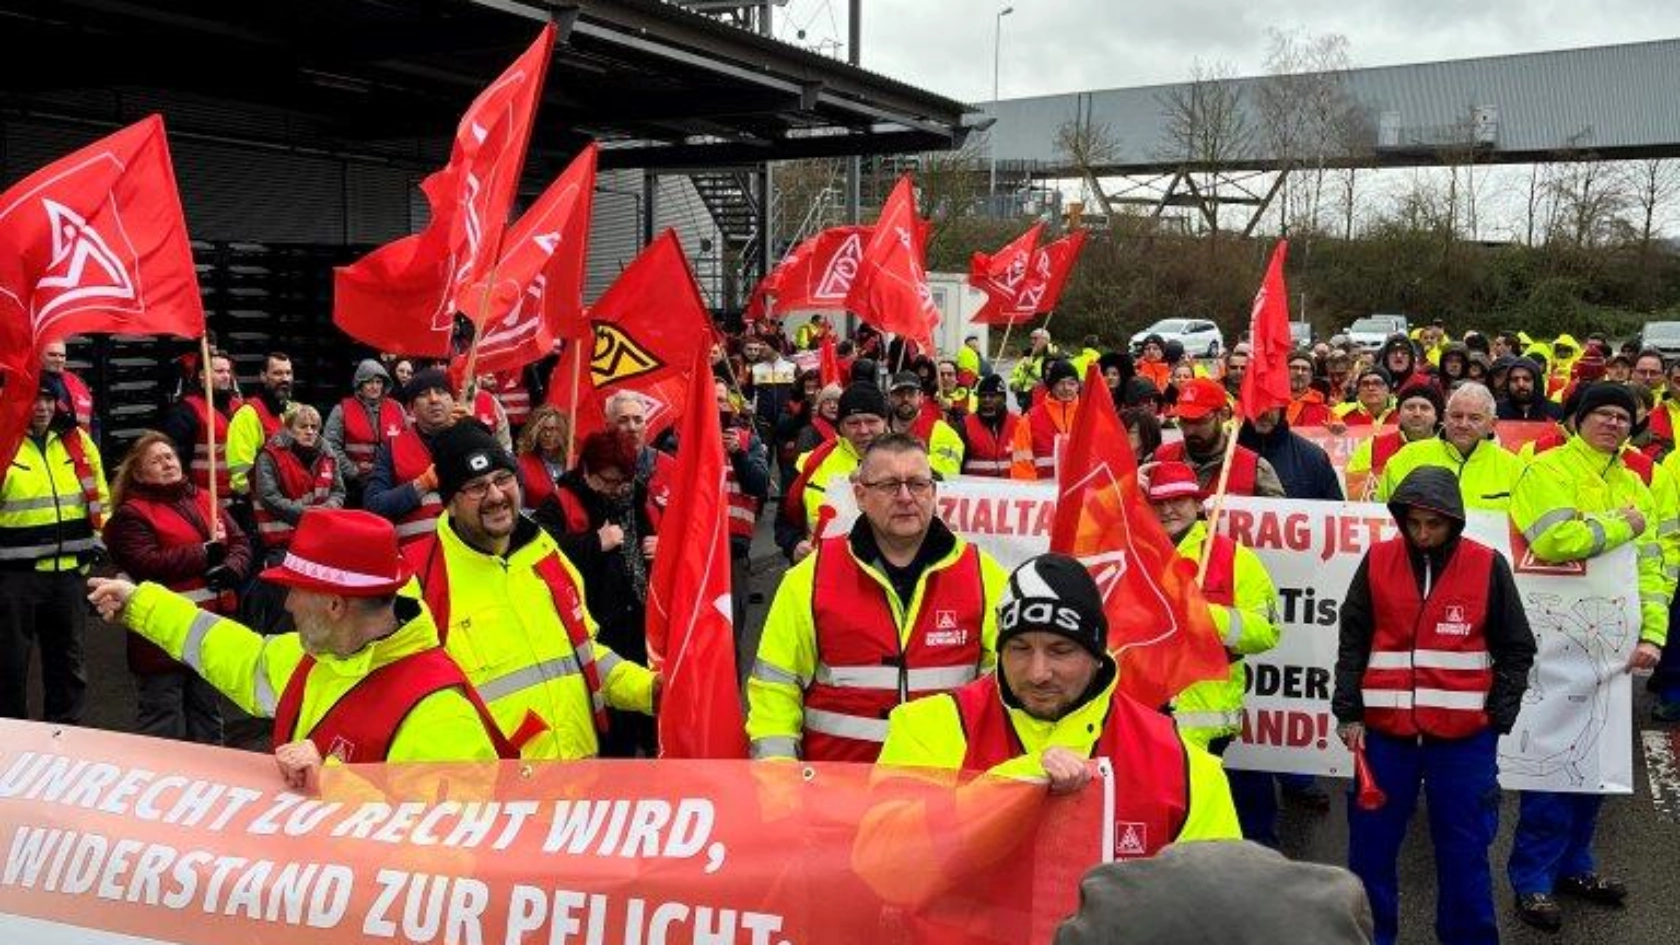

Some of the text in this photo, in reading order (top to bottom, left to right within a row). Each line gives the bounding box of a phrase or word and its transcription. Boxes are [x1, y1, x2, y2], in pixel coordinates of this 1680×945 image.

[939, 497, 1056, 536] ZIALTA
[1321, 515, 1401, 562] JET
[1003, 599, 1081, 630] das
[1279, 587, 1337, 625] Tis
[0, 752, 726, 873] UNRECHT ZU RECHT WIRD,
[3, 826, 353, 928] WIDERSTAND
[363, 868, 489, 945] ZUR
